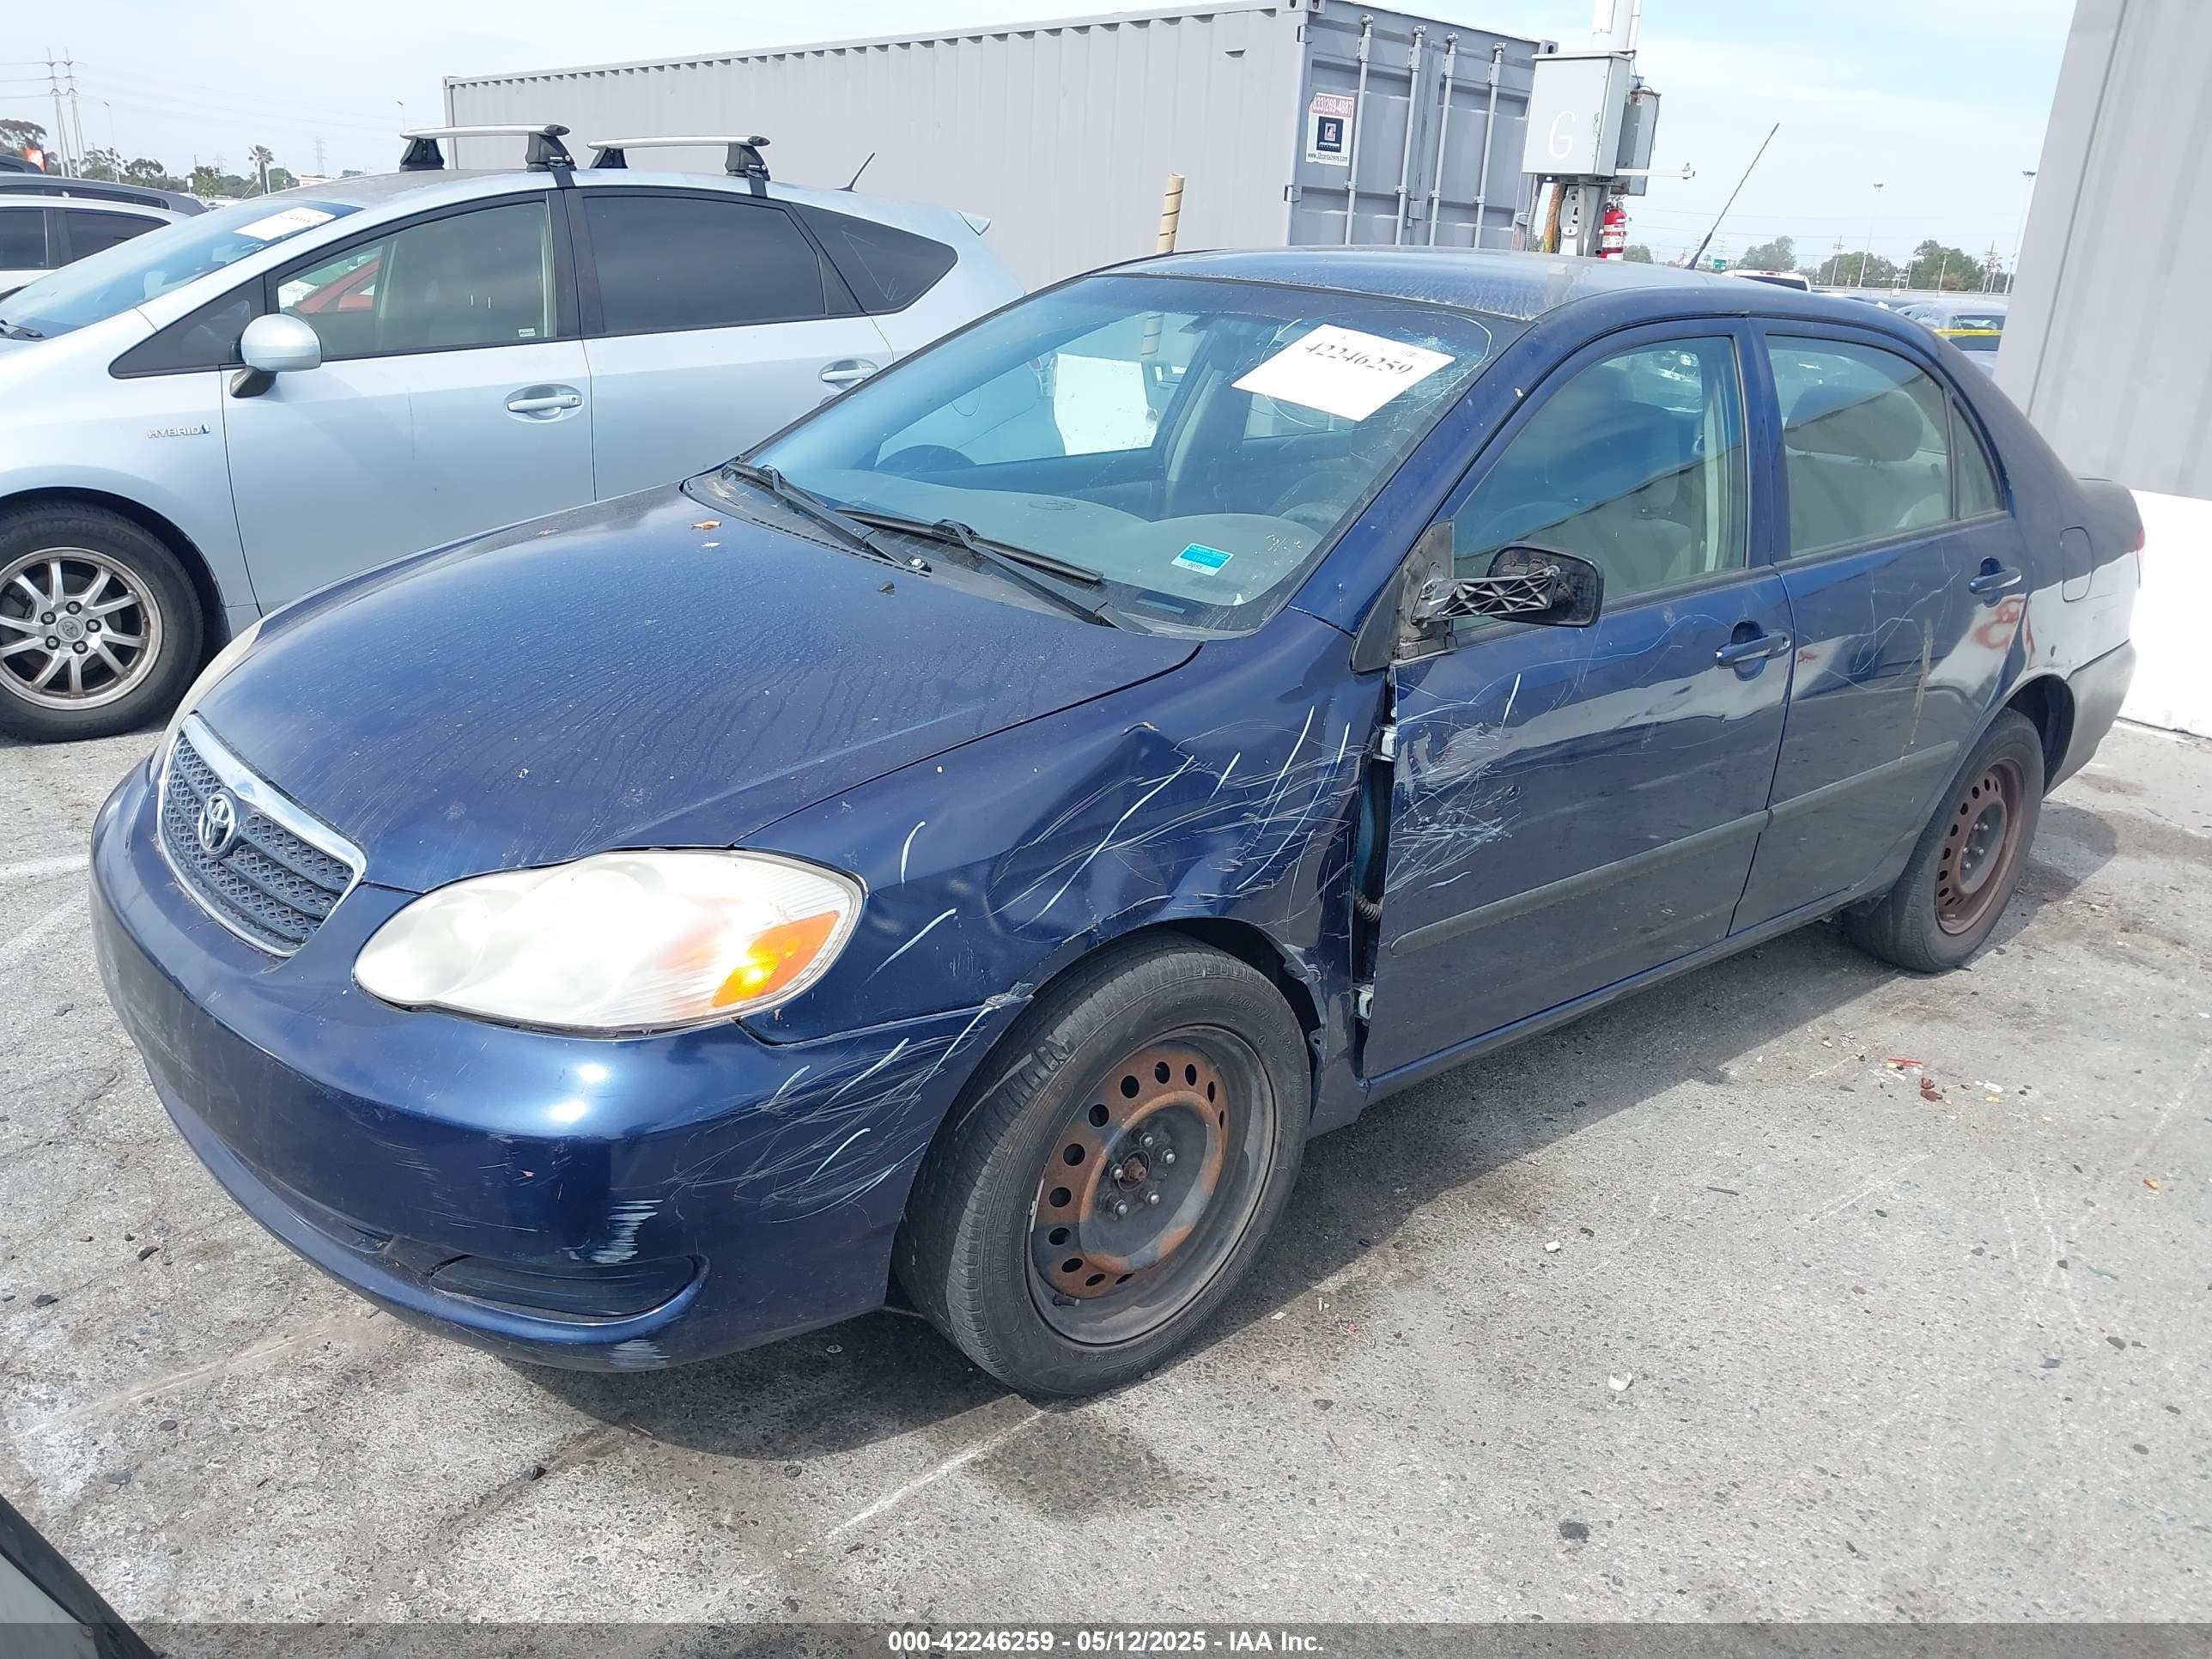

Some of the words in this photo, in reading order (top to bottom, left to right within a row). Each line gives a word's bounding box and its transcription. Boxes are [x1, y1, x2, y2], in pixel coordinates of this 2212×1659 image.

[1547, 110, 1577, 159] G
[1304, 342, 1414, 374] 42246259
[148, 426, 201, 439] HYBRID
